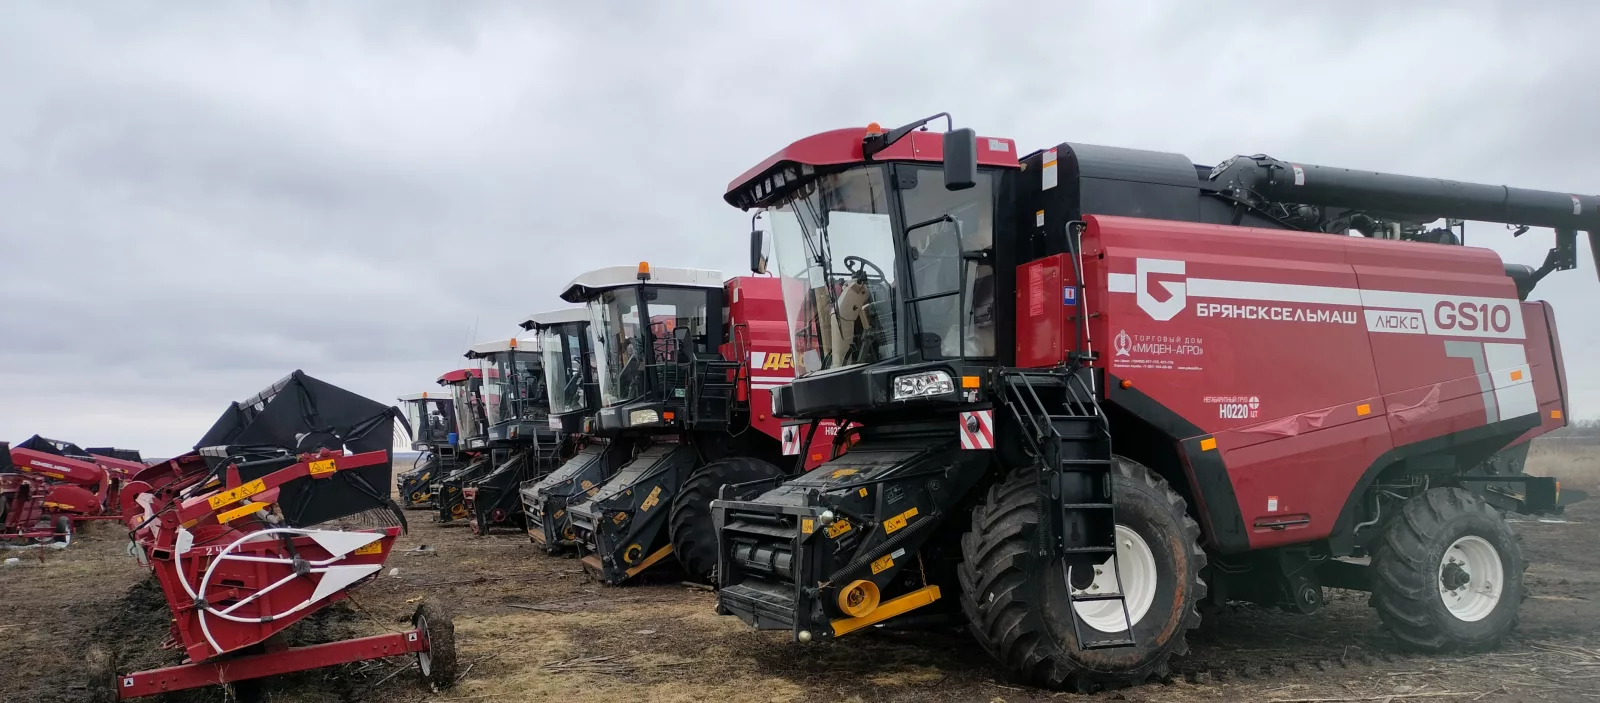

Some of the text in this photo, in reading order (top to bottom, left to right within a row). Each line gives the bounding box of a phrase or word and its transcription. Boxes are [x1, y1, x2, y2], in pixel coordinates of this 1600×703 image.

[1196, 303, 1357, 324] БРЯНСКСЕЛЬМАШ
[1375, 315, 1419, 330] ЛЮКС
[1434, 300, 1511, 333] GS10
[1134, 334, 1203, 345] ТОРГОВЫЙ ДОМ
